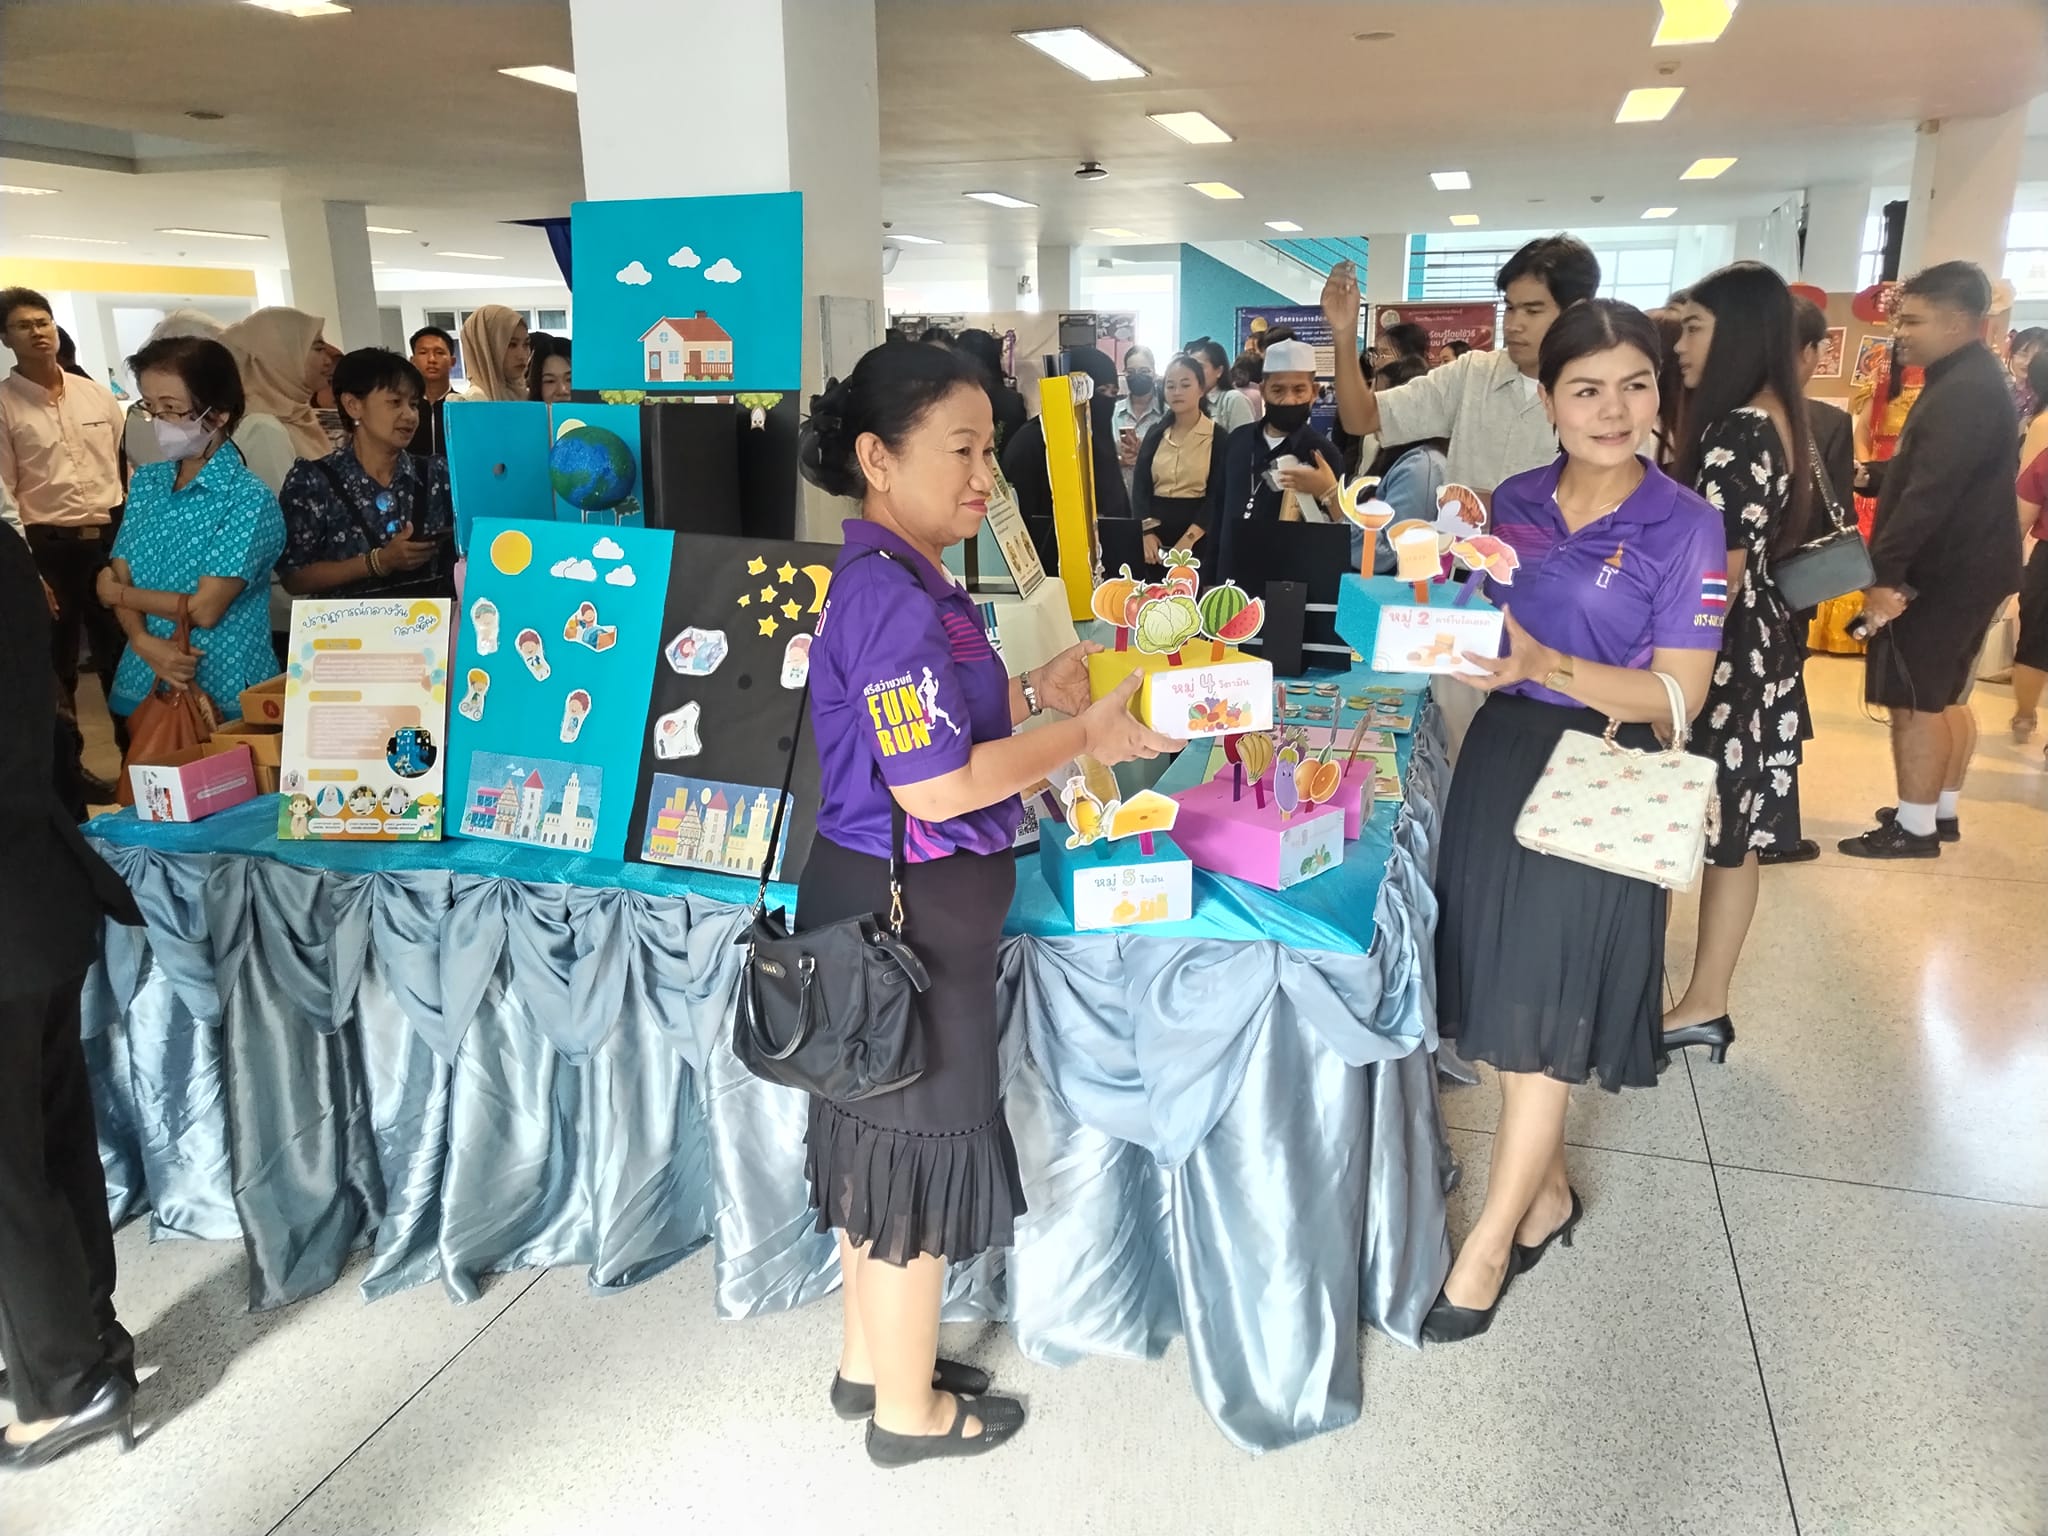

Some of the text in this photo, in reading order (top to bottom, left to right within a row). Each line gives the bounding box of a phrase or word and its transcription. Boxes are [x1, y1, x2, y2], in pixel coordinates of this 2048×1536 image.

[302, 601, 409, 628] ปรากฏการณ์กลางวัน
[1389, 609, 1412, 628] หมู่
[1417, 611, 1430, 625] 2
[1171, 678, 1195, 698] หมู่
[866, 684, 924, 730] FUN
[876, 719, 932, 757] RUN
[1094, 874, 1117, 892] หมู่
[1122, 869, 1136, 886] 5
